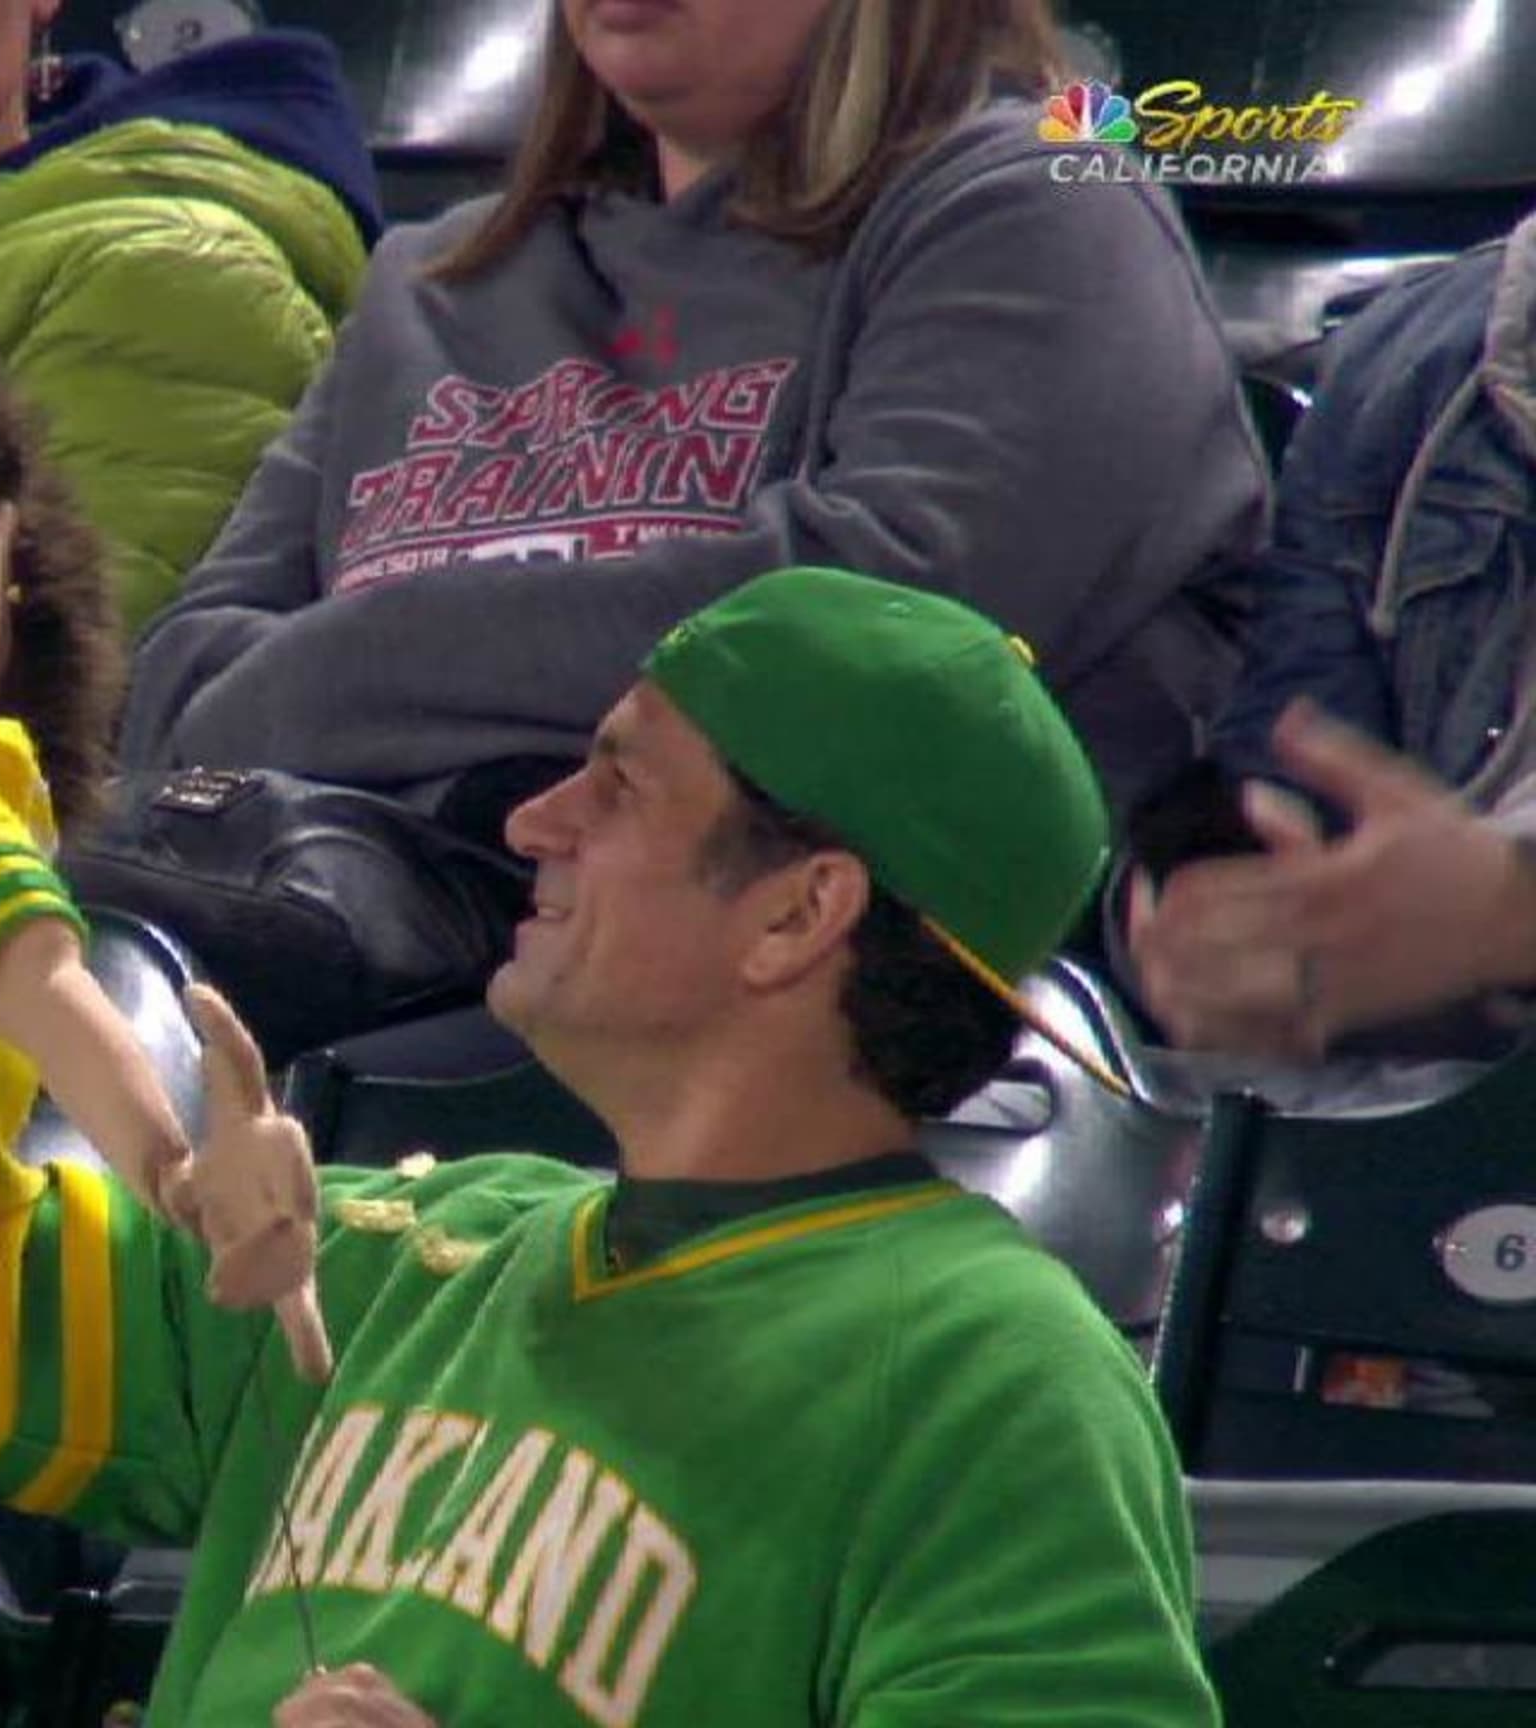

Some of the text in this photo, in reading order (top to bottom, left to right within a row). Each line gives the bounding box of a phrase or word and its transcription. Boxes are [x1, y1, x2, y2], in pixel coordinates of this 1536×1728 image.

[342, 430, 767, 549] TRAININ
[1495, 1233, 1526, 1272] 6
[249, 1404, 699, 1728] AKAND
